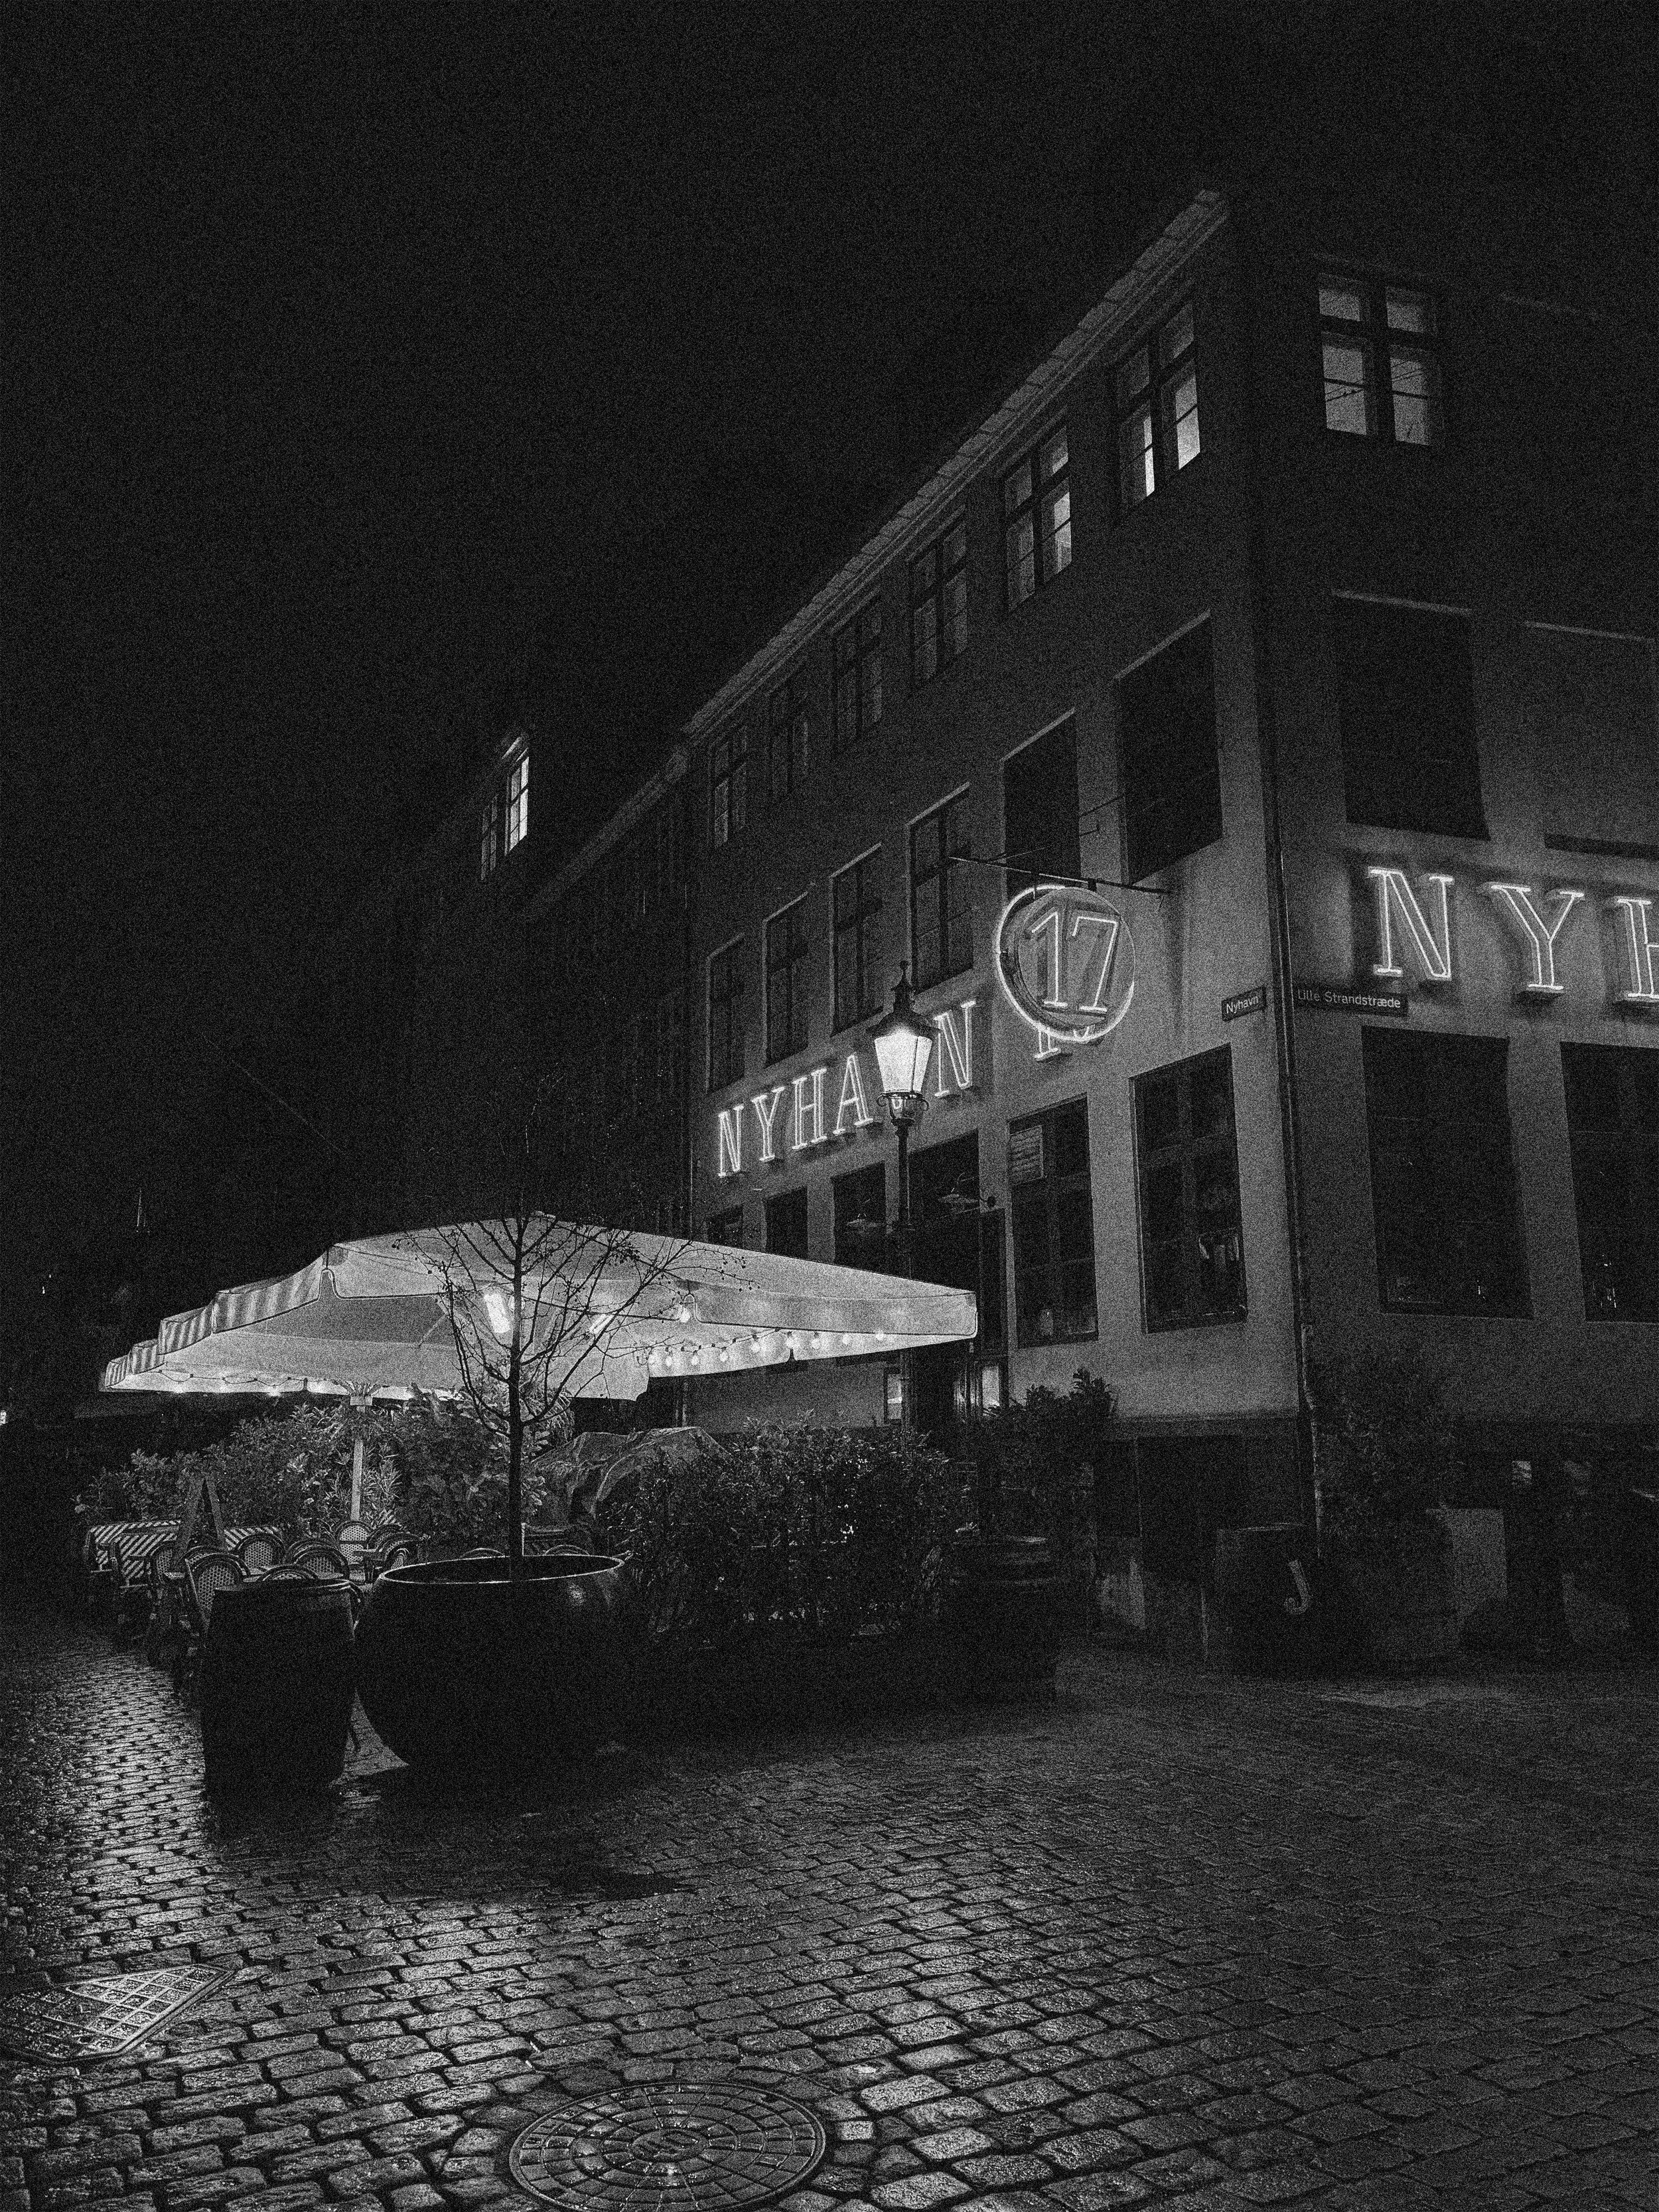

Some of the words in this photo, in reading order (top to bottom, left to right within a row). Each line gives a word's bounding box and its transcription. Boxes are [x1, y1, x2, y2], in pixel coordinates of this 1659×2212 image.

[1027, 904, 1121, 1015] 17
[1226, 995, 1260, 1015] Nyhavn
[1297, 988, 1321, 1002] Lille
[1323, 990, 1402, 1009] Strandstræde
[717, 999, 976, 1177] NYHAN
